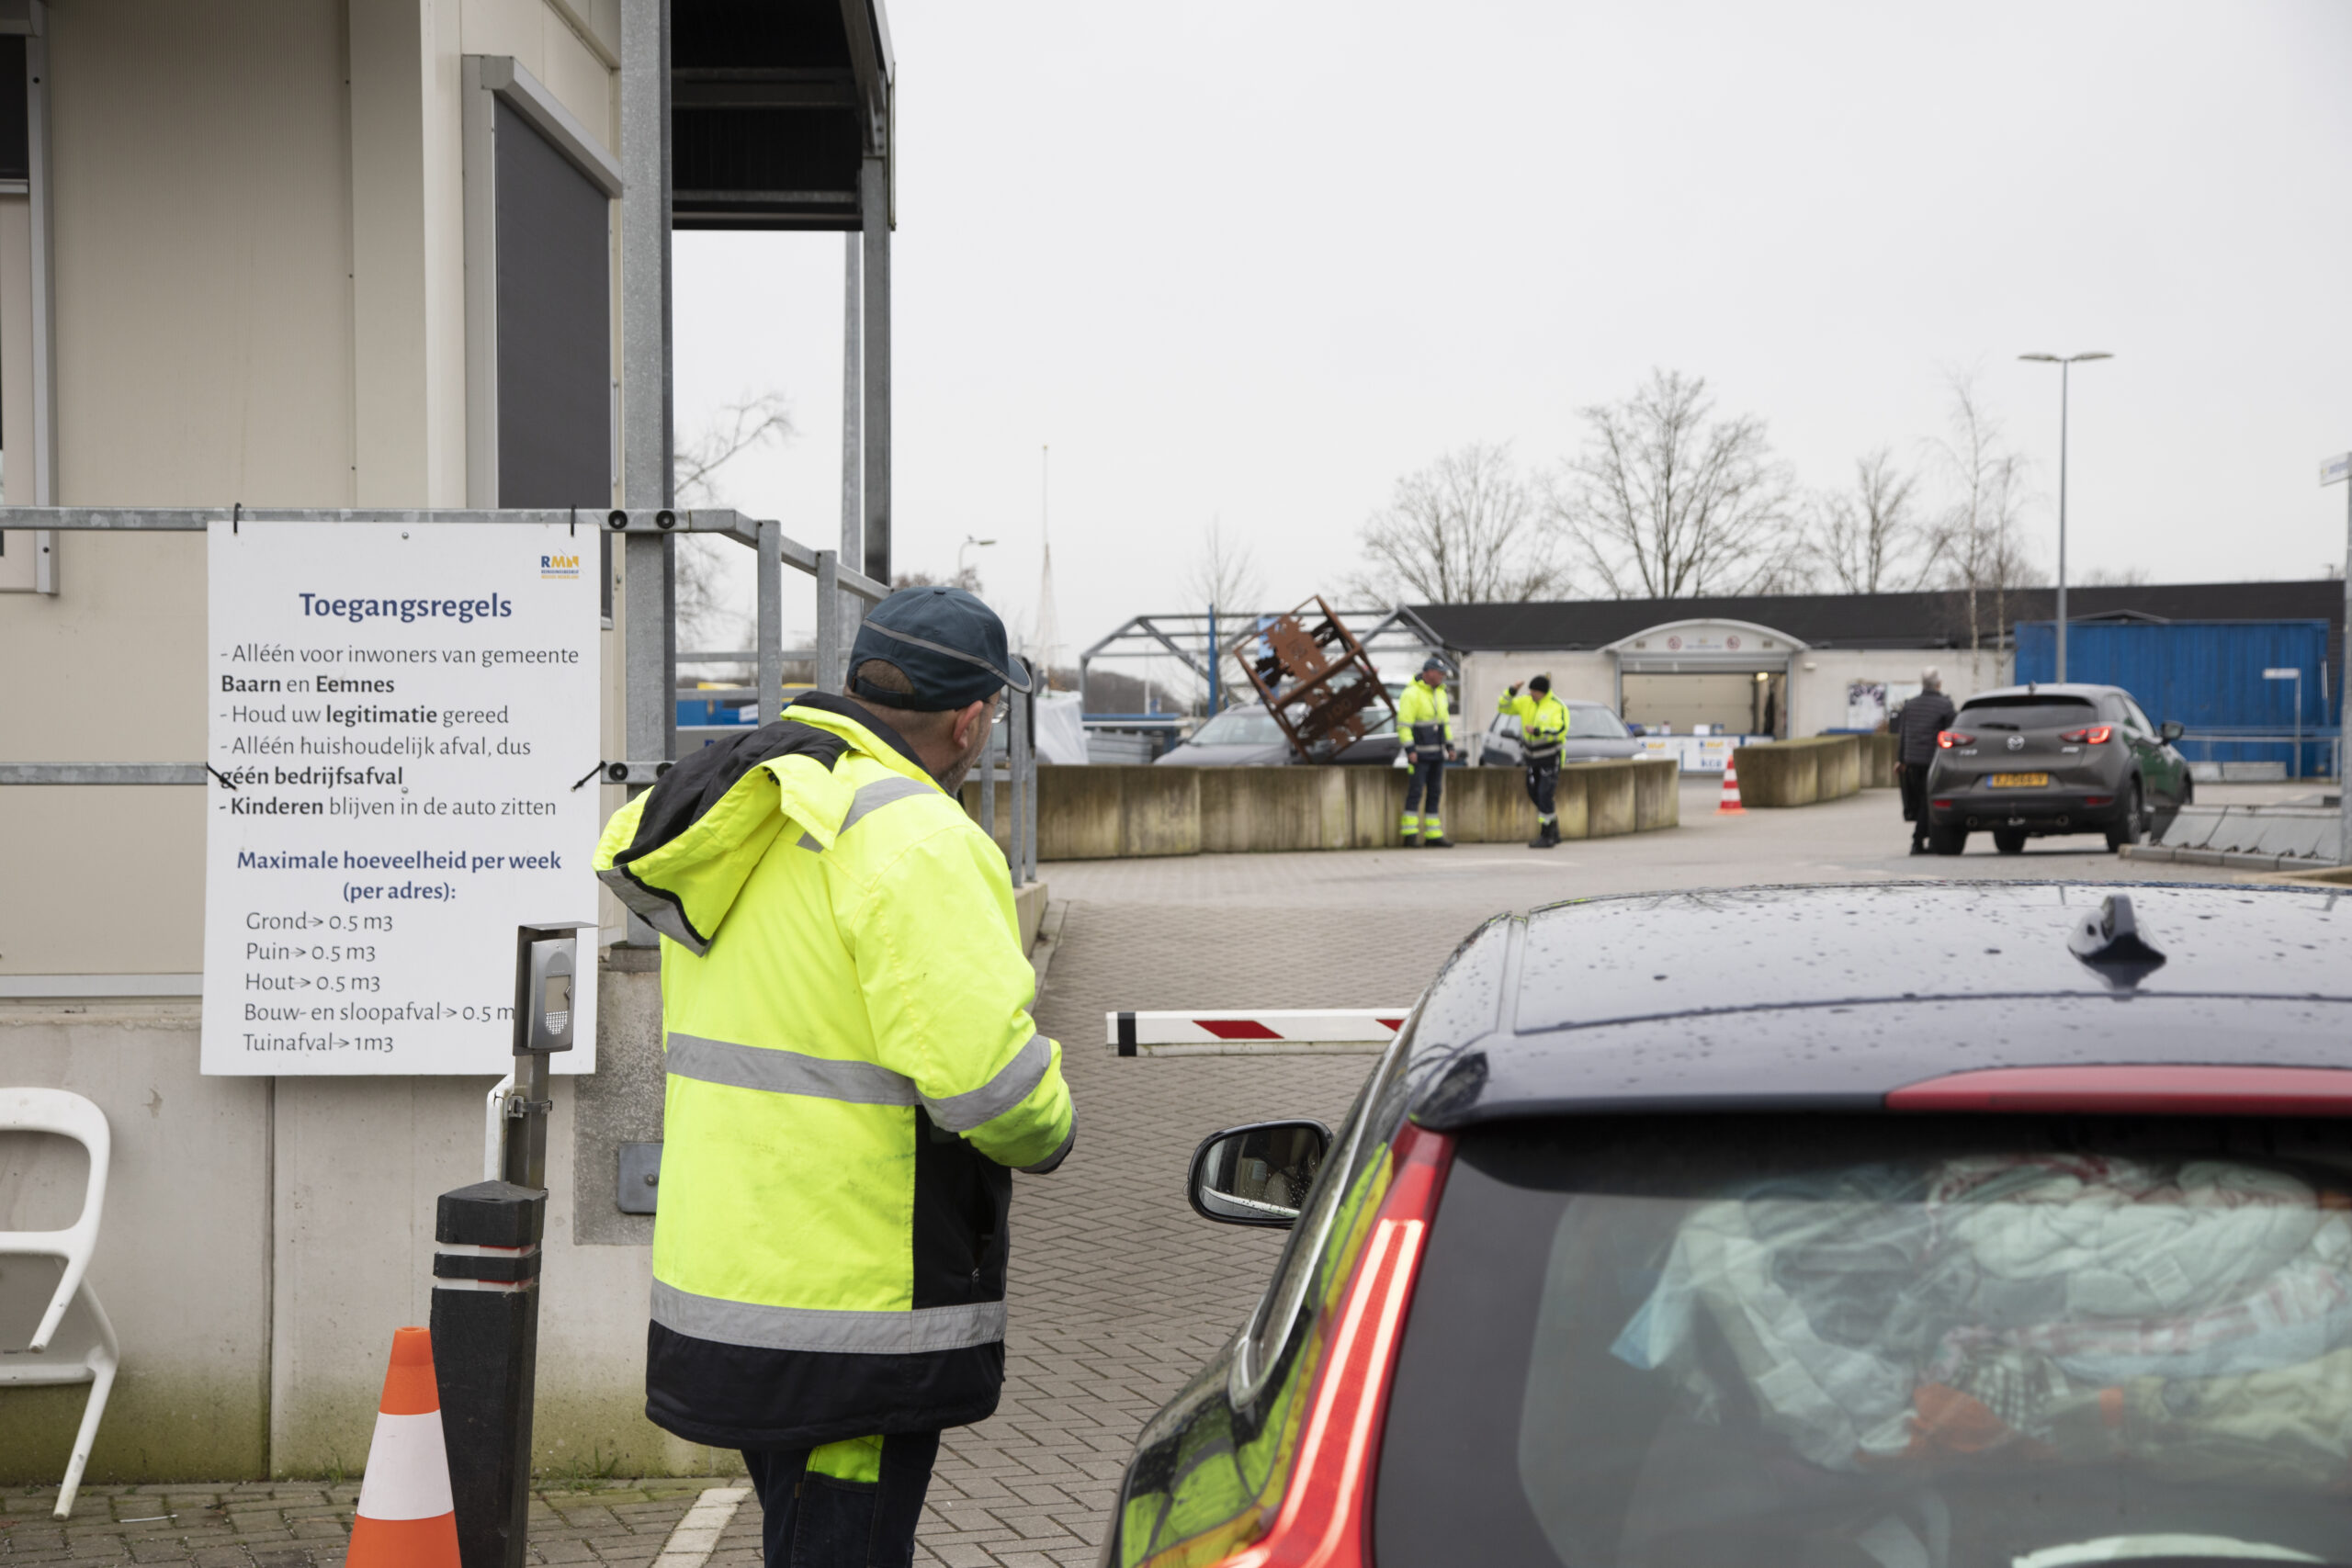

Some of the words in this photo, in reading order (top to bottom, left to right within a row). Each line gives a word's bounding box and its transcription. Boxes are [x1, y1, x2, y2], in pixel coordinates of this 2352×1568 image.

[540, 556, 579, 569] RMN
[299, 592, 512, 624] Toegangsregels
[232, 643, 295, 663] Alléén
[300, 649, 343, 663] voor
[348, 645, 437, 663] inwoners
[442, 650, 476, 663] van
[481, 649, 579, 668] gemeente
[221, 675, 281, 693] Baarn
[287, 680, 310, 694] en
[316, 675, 394, 693] Eemnes
[232, 705, 286, 723] Houd
[292, 710, 322, 723] uw
[326, 705, 437, 728] legitimatie
[442, 705, 509, 728] gereed
[232, 736, 295, 755] Alléén
[301, 736, 435, 759] huishoudelijk
[440, 736, 492, 758] afval,
[497, 737, 531, 755] dus
[220, 766, 269, 788] géén
[275, 766, 403, 787] bedrijfsafval
[231, 796, 324, 815] Kinderen
[330, 796, 395, 819] blijven
[401, 797, 417, 815] in
[424, 796, 447, 815] de
[452, 800, 496, 815] auto
[501, 798, 556, 816] zitten
[237, 851, 338, 869] Maximale
[344, 851, 467, 869] hoeveelheid
[471, 855, 504, 874] per
[509, 851, 561, 870] week
[343, 882, 384, 904] (per
[388, 881, 456, 902] adres):
[329, 916, 358, 931] 0.5
[364, 916, 393, 932] m3
[311, 946, 341, 962] 0.5
[346, 946, 376, 962] m3
[316, 976, 345, 992] 0.5
[351, 976, 380, 992] m3
[244, 1003, 307, 1021] Bouw-
[311, 1008, 334, 1021] en
[462, 1007, 492, 1022] 0.5
[496, 1007, 515, 1021] m
[355, 1037, 394, 1054] 1m3
